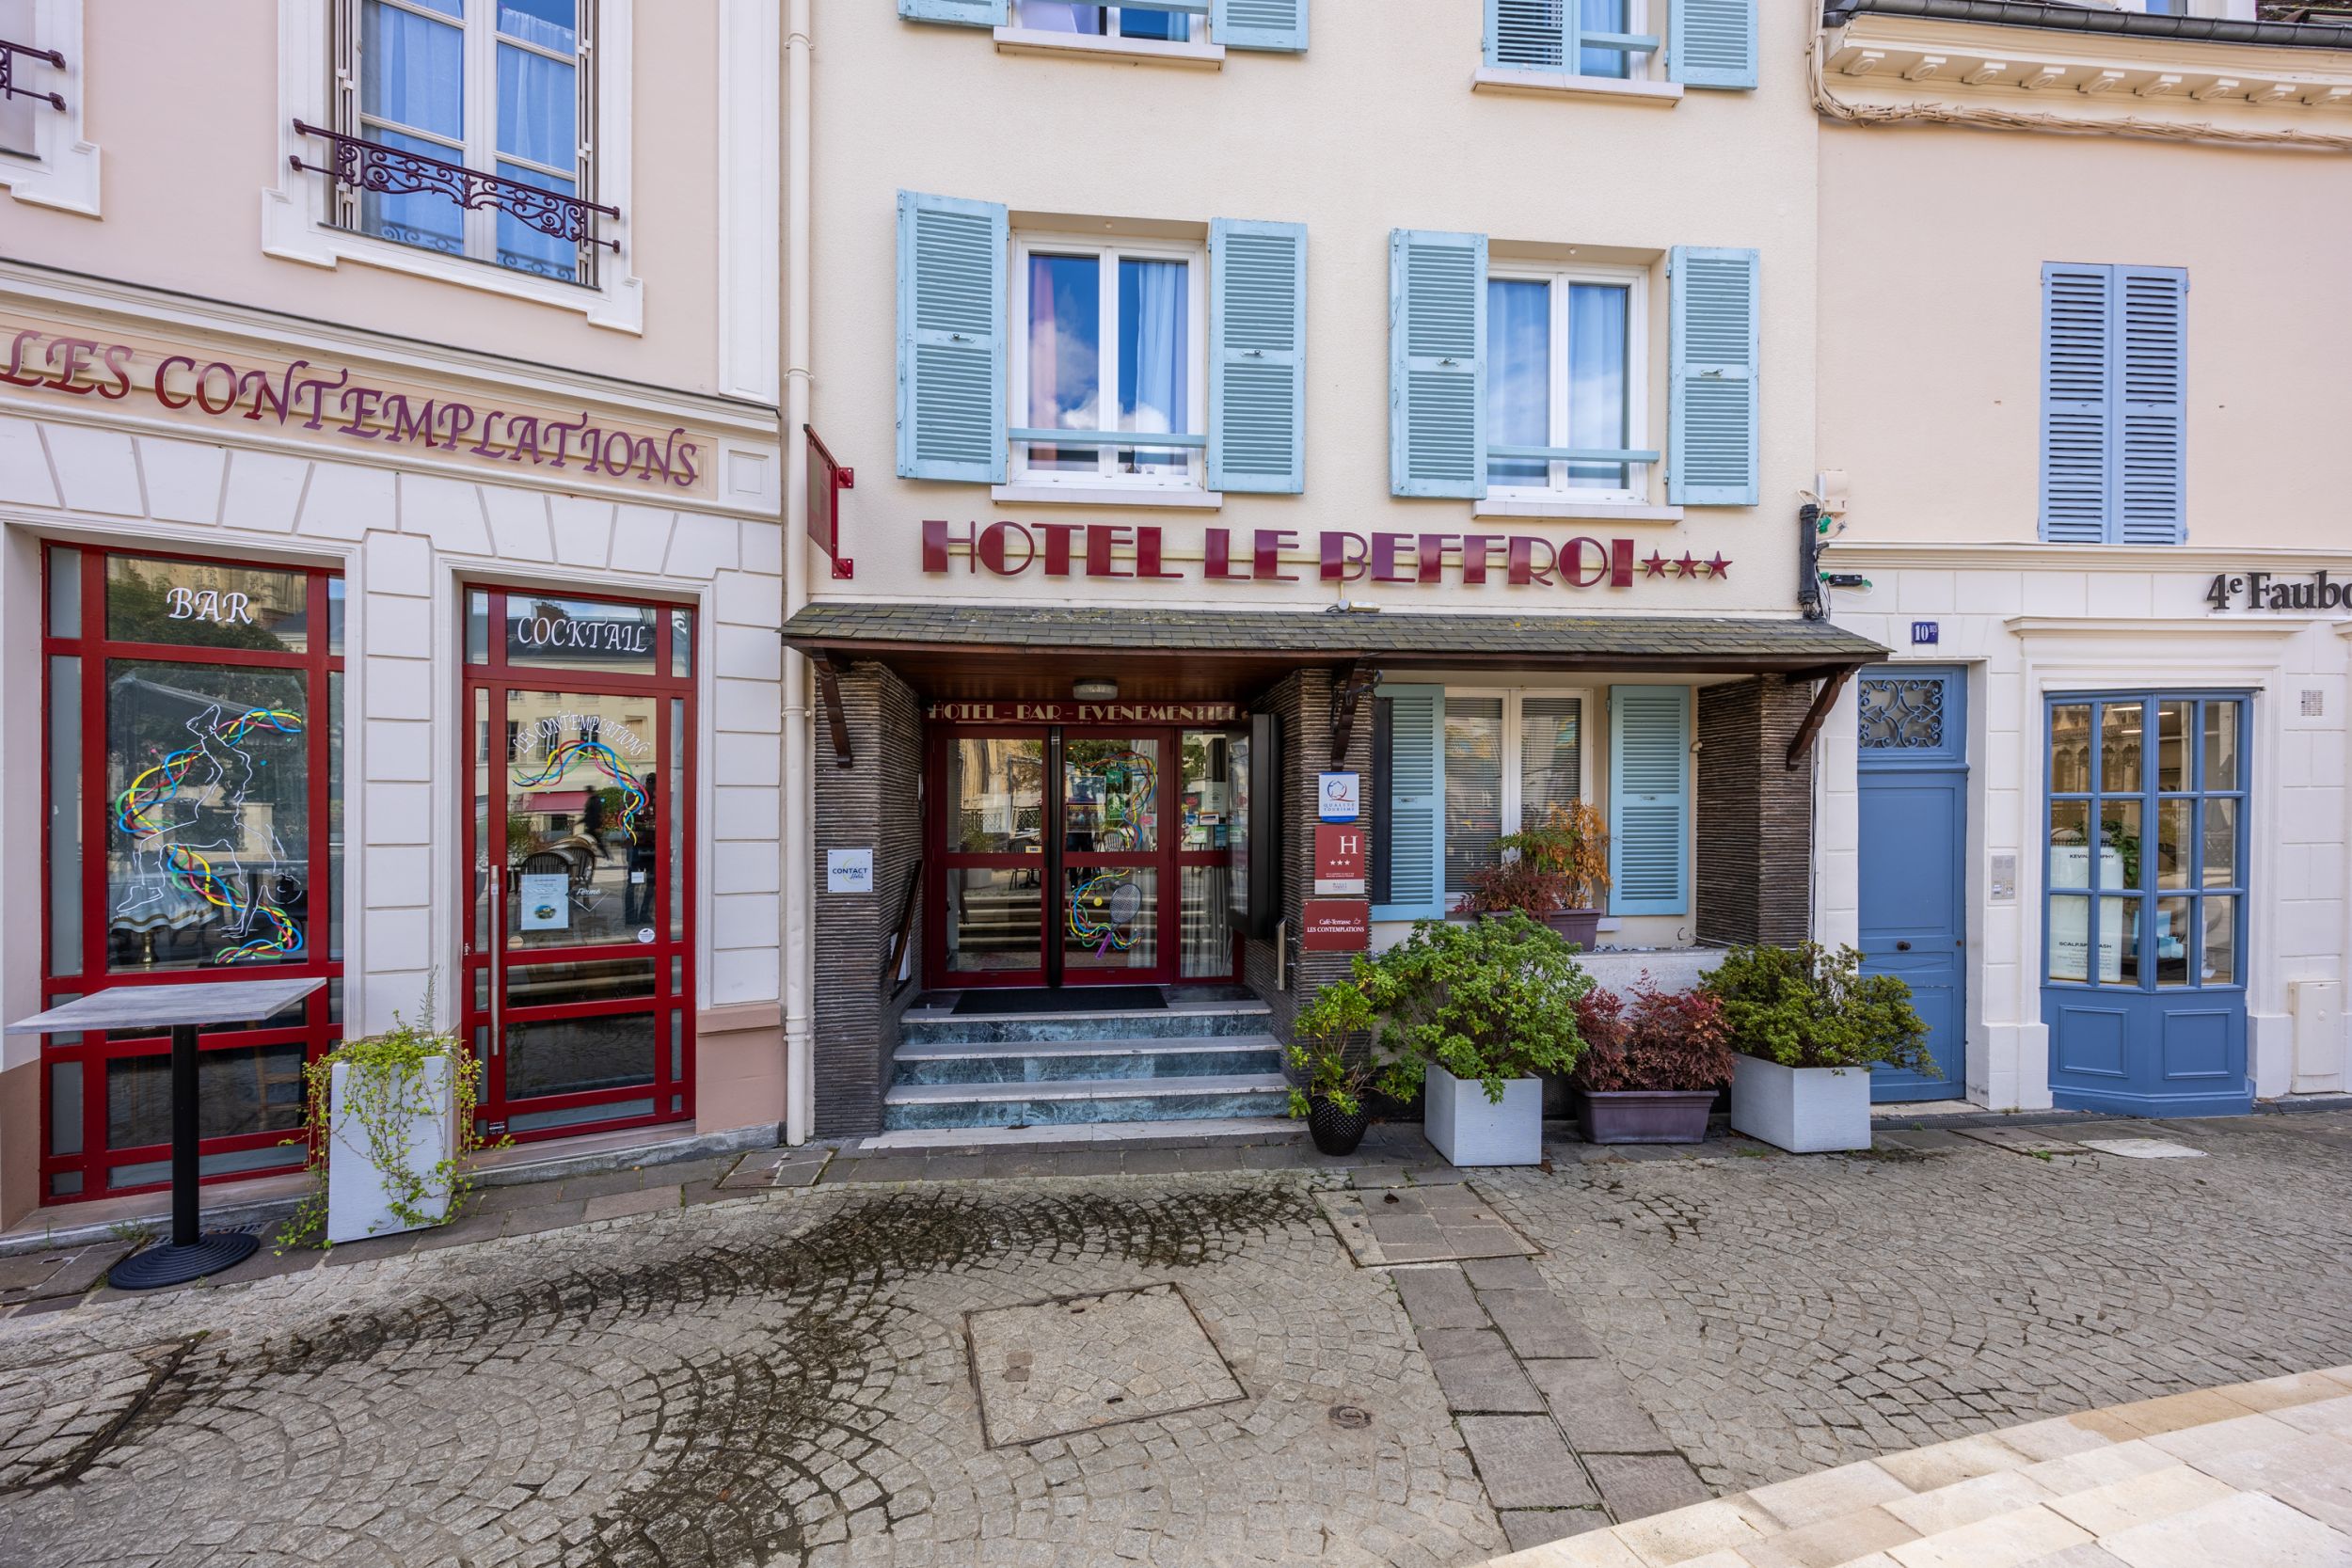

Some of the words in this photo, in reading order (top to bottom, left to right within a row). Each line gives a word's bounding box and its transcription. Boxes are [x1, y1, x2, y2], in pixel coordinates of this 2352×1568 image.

[0, 329, 134, 400] LES
[154, 355, 700, 487] CONTEMPLATIONS
[922, 519, 1184, 578] HOTEL
[1203, 528, 1300, 581] LE
[1319, 531, 1635, 588] BEFFROI
[166, 586, 253, 626] BAR
[517, 616, 647, 653] COCKTAIL
[1915, 624, 1929, 641] 10
[928, 704, 1000, 720] HOTEL
[1017, 705, 1061, 721] BAR
[513, 727, 539, 753] LES
[533, 709, 651, 756] CONTEMPLATIONS
[1339, 835, 1359, 855] H
